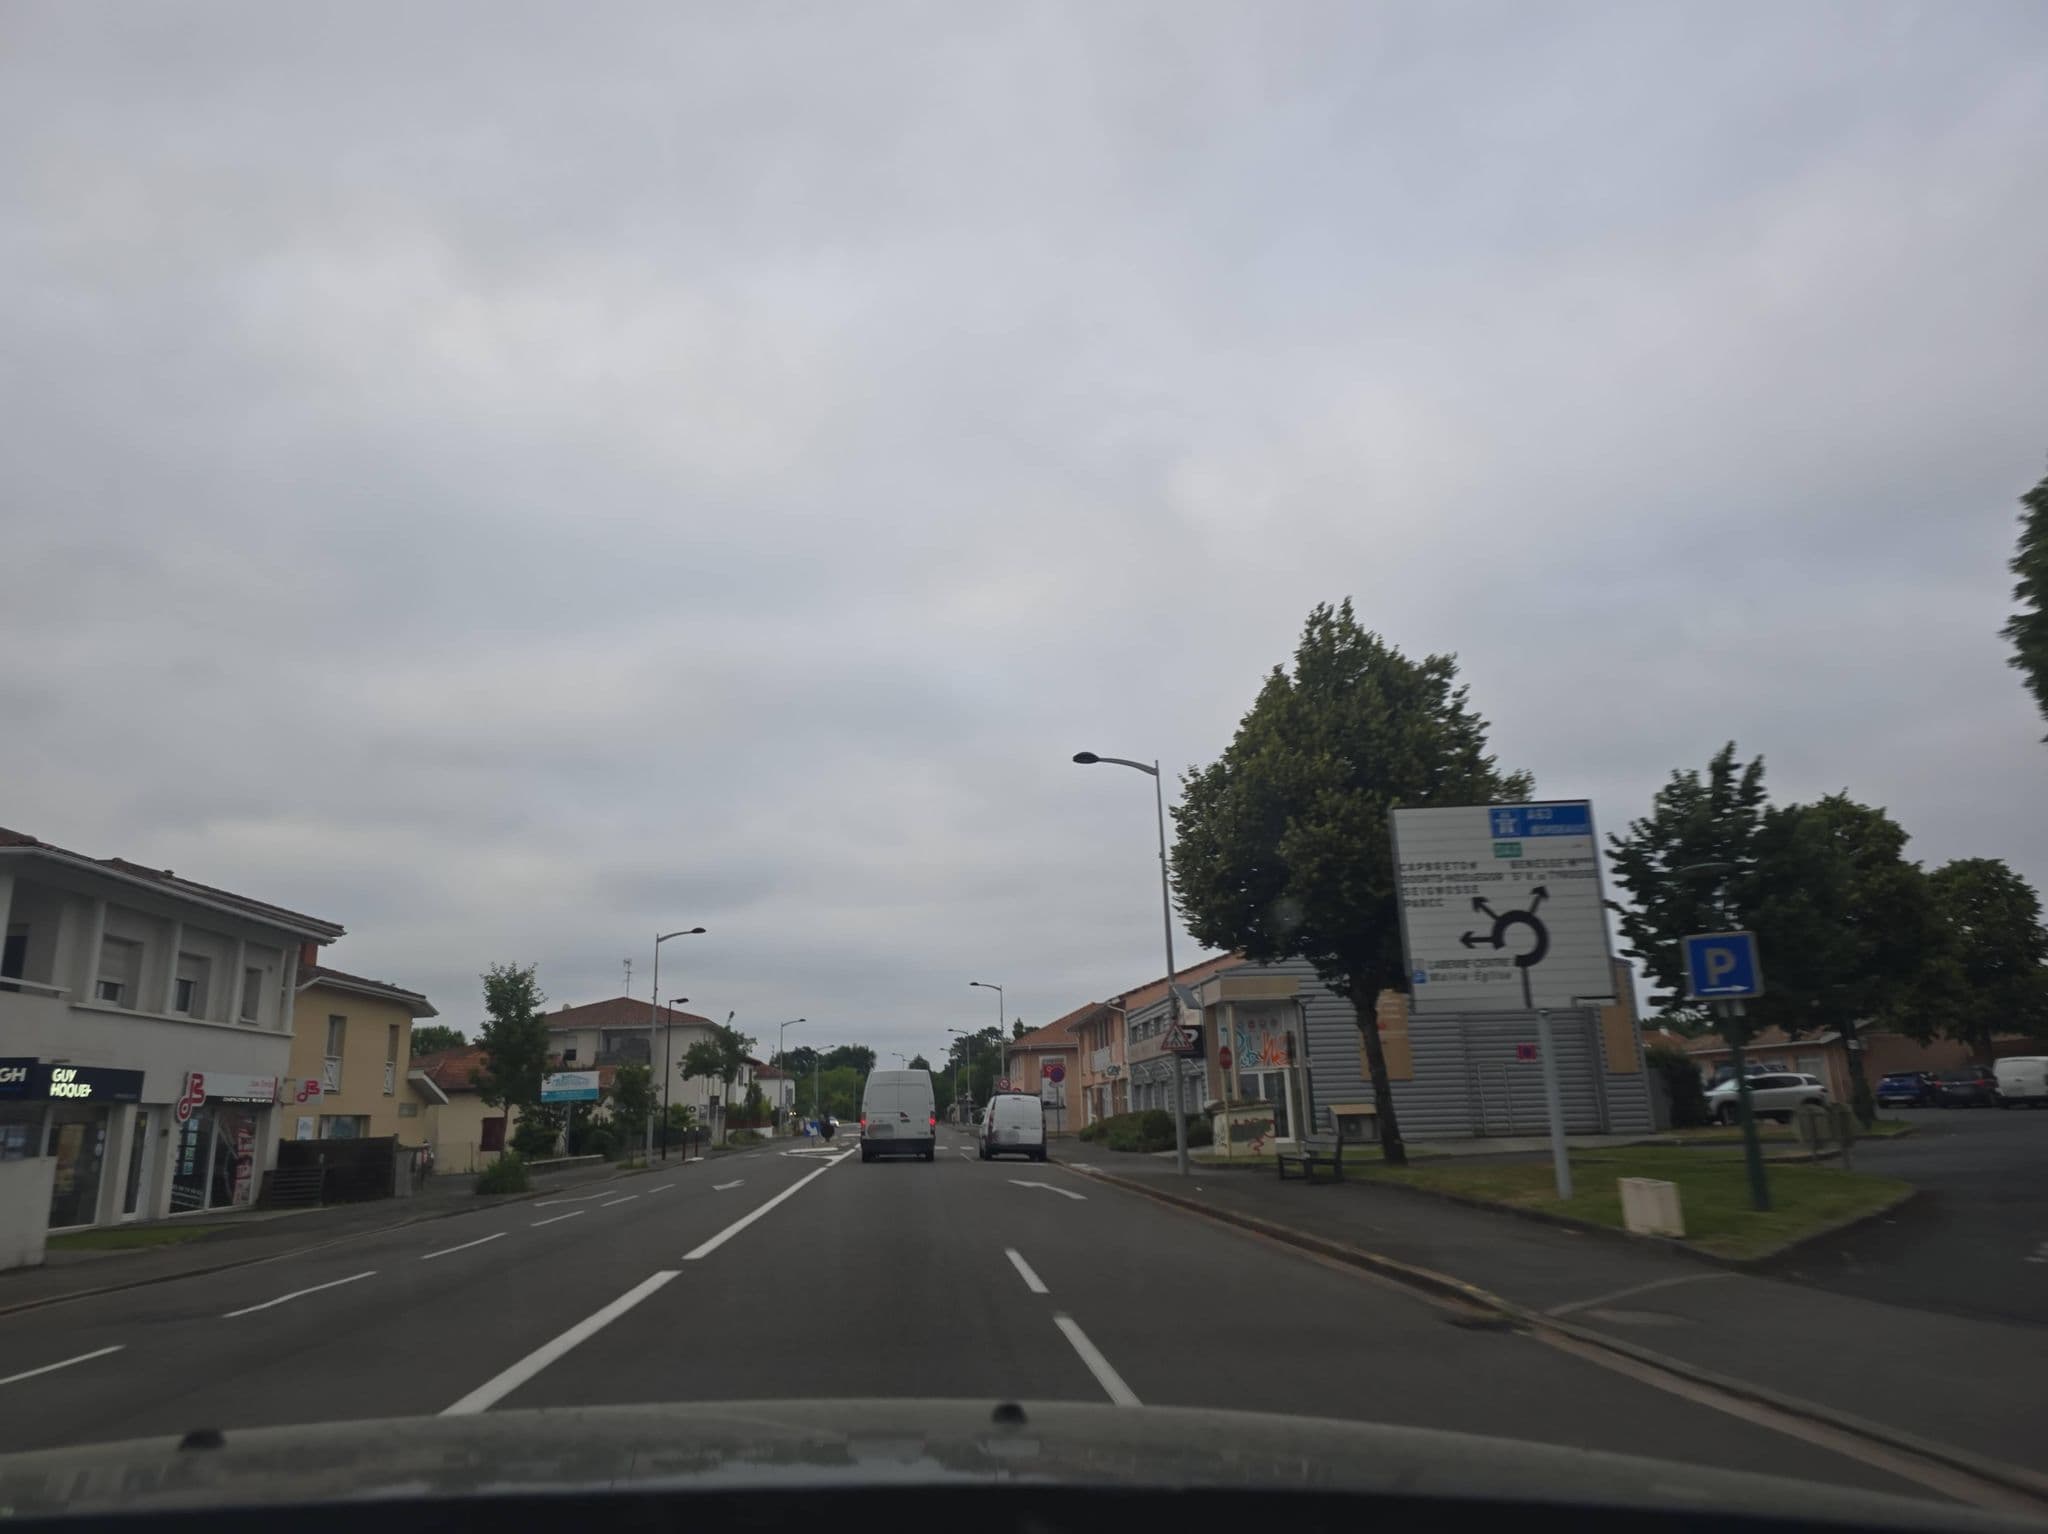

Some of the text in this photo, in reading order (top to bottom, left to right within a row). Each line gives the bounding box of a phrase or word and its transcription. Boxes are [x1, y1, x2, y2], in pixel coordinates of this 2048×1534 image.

[1704, 947, 1736, 986] P
[0, 1067, 27, 1082] GH
[52, 1068, 77, 1082] GUY
